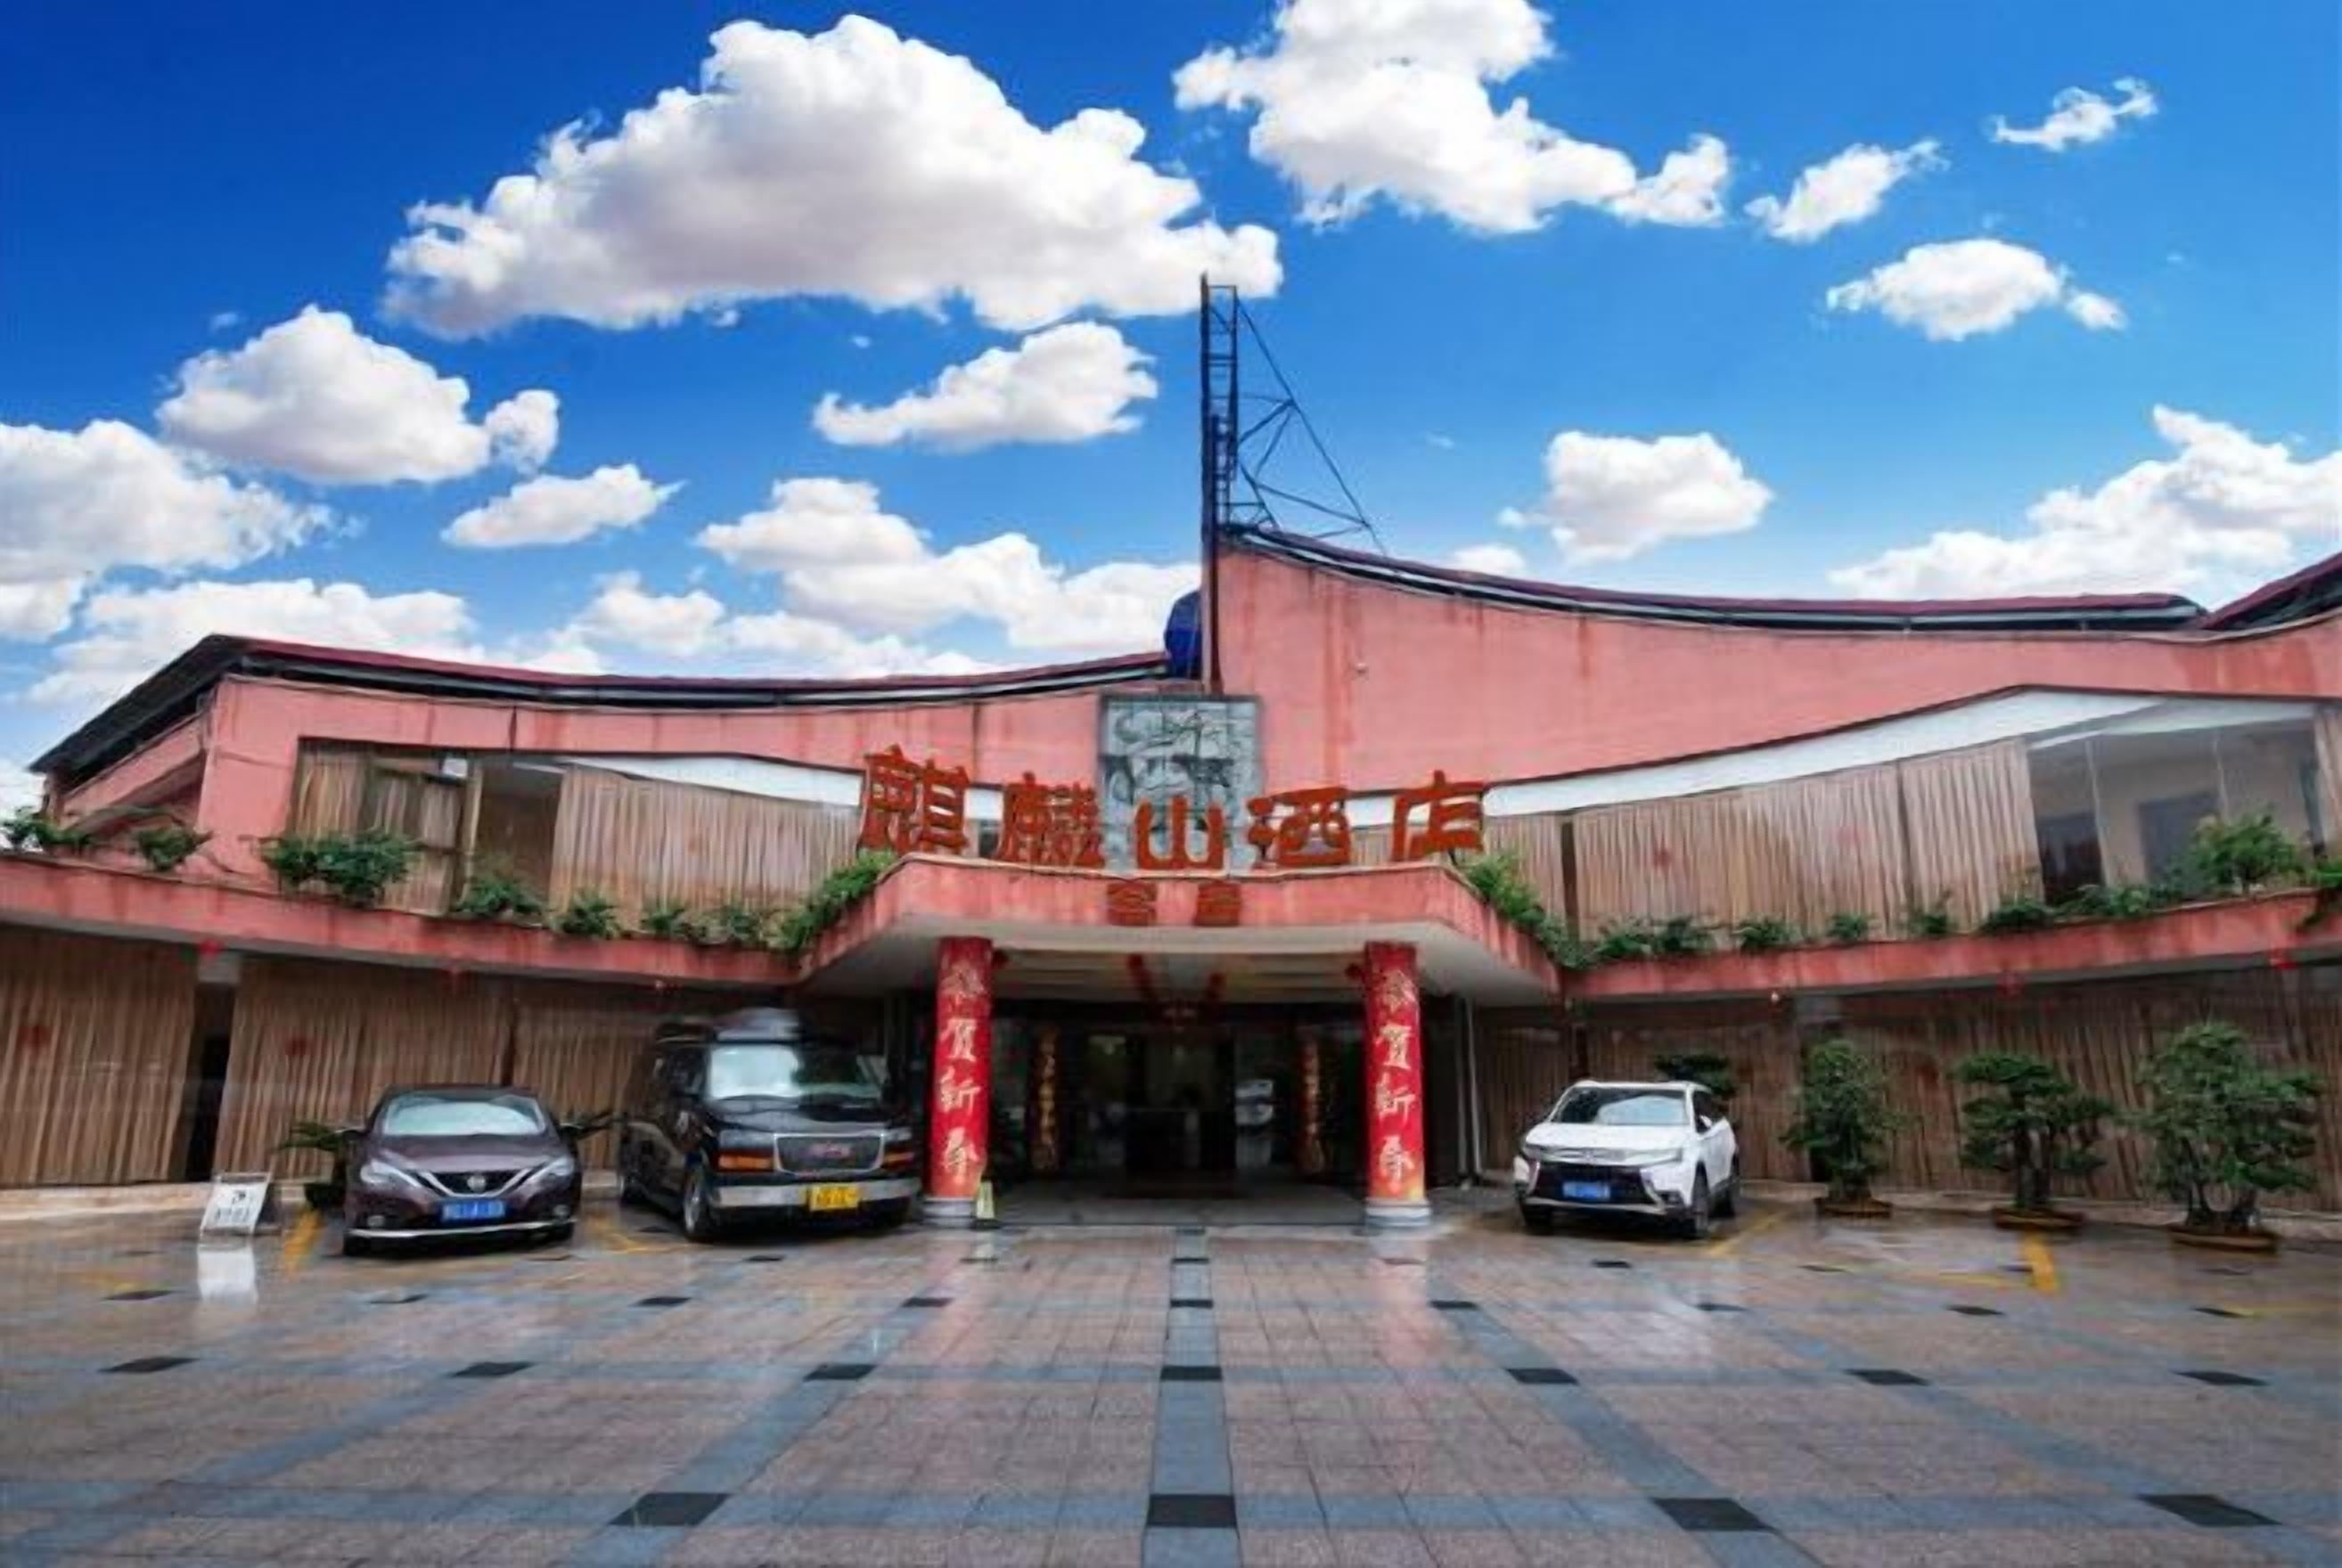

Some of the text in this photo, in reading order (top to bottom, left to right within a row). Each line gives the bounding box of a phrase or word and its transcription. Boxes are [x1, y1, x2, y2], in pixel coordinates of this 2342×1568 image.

[857, 743, 1485, 870] 麒麟山酒店
